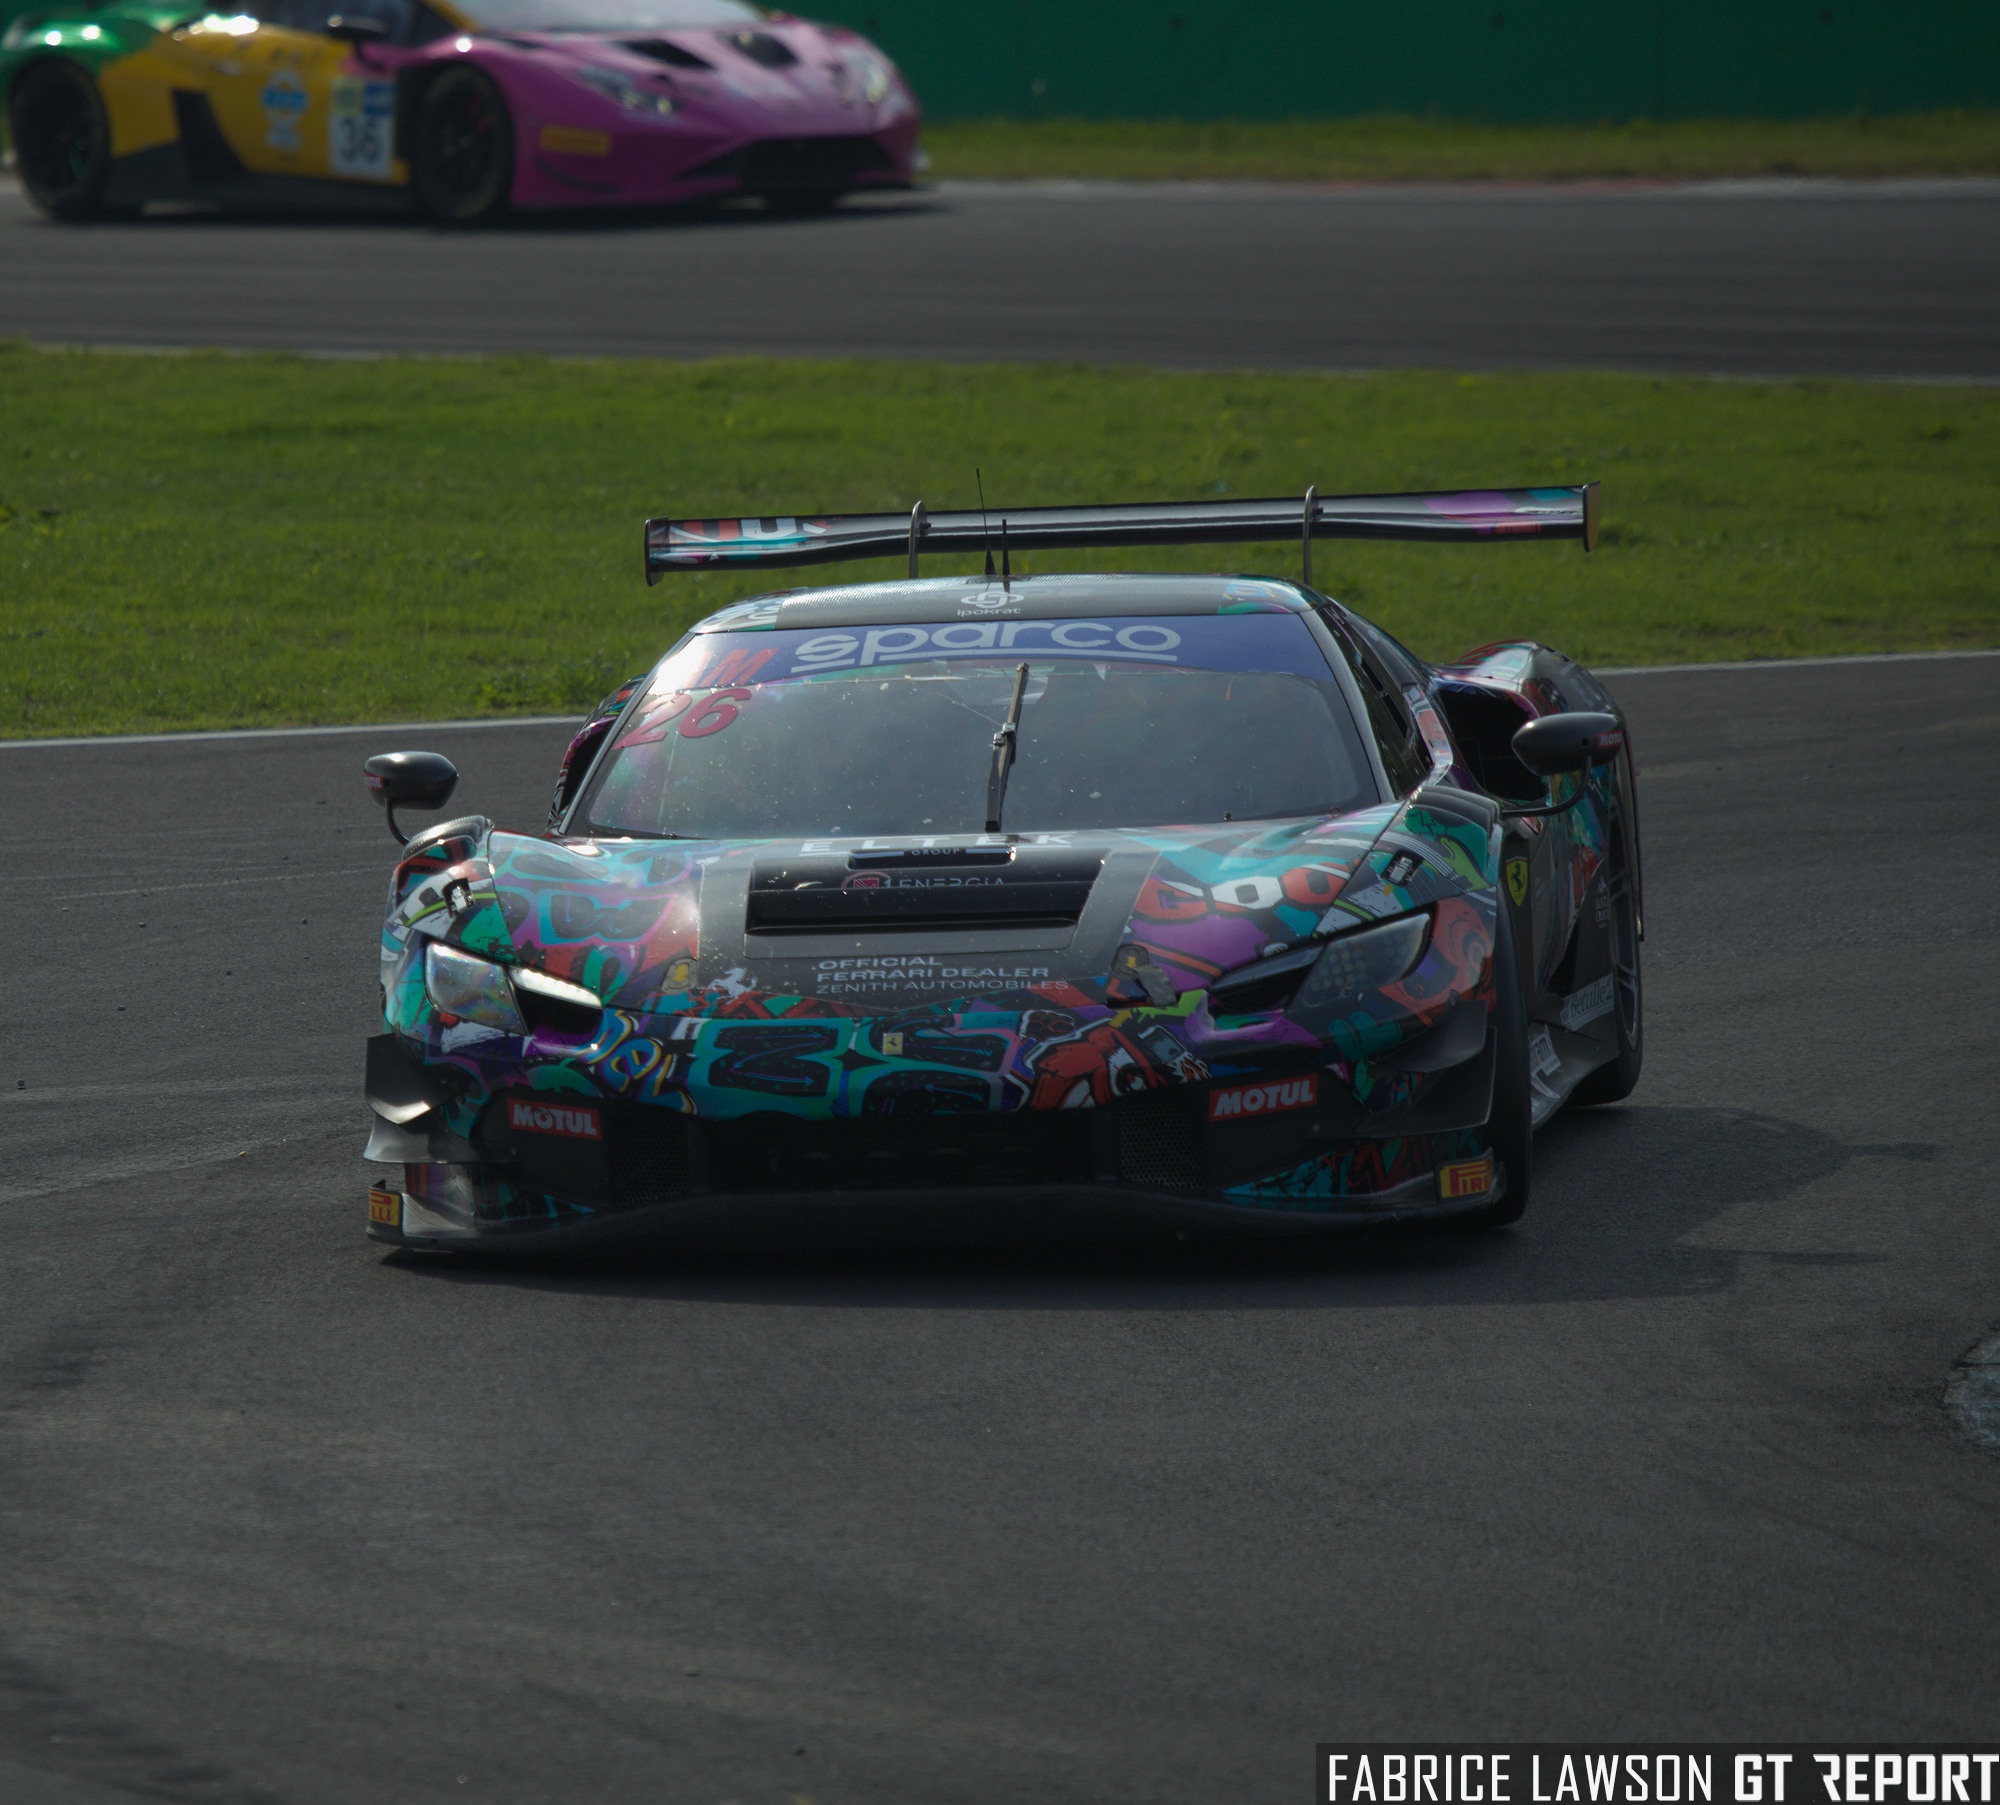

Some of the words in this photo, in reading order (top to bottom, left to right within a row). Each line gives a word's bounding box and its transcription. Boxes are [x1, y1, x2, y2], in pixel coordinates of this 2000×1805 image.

[339, 118, 381, 162] 36
[795, 621, 1181, 666] sparco
[612, 688, 752, 750] 26
[816, 968, 934, 983] FERRARI
[941, 967, 1050, 979] DEALER
[818, 956, 943, 971] OFFICIAL
[816, 982, 898, 994] ZENITH
[903, 980, 1069, 991] AUTOMOBILES
[1213, 1079, 1314, 1117] MOTUL
[513, 1103, 597, 1136] MOTUL
